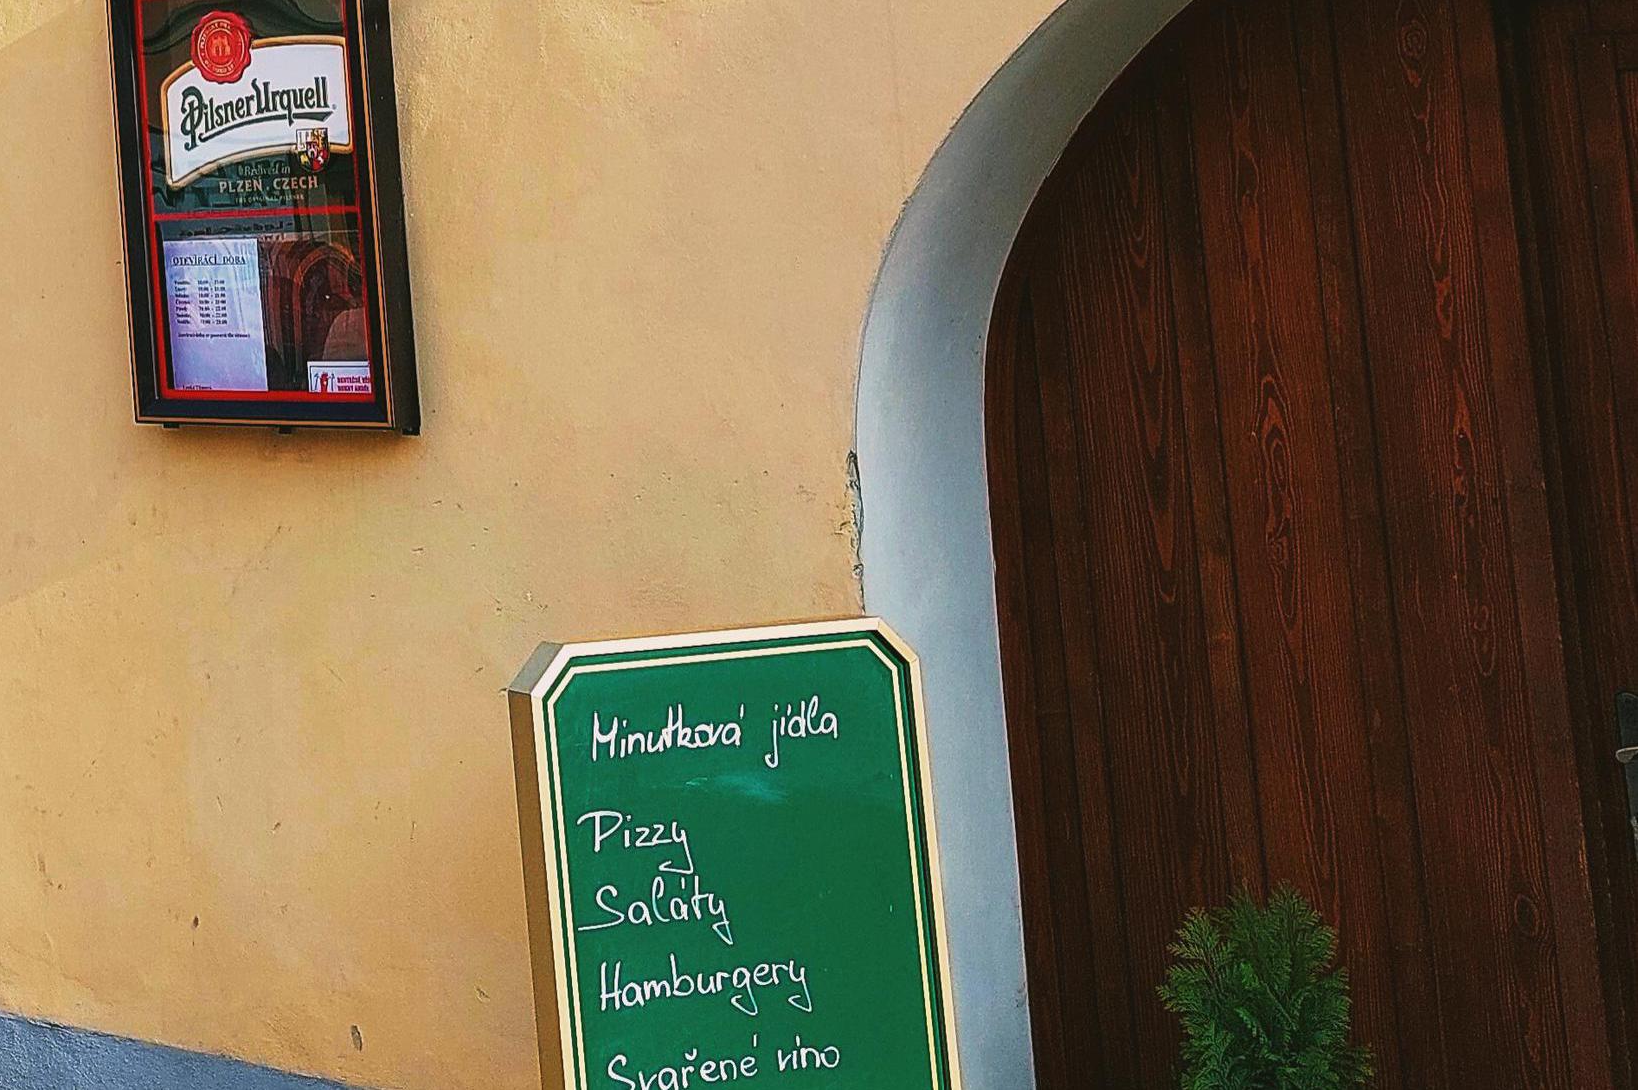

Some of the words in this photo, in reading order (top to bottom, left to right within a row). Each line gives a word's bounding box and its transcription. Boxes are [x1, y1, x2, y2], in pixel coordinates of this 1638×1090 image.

[180, 86, 257, 152] Pilsner
[251, 76, 330, 127] Urquell
[272, 174, 319, 190] CZECH
[591, 703, 746, 762] Minutková
[764, 695, 839, 768] jídla
[576, 810, 695, 876] Pizzy
[577, 875, 734, 946] Saláty
[599, 953, 813, 1017] Hamburgery
